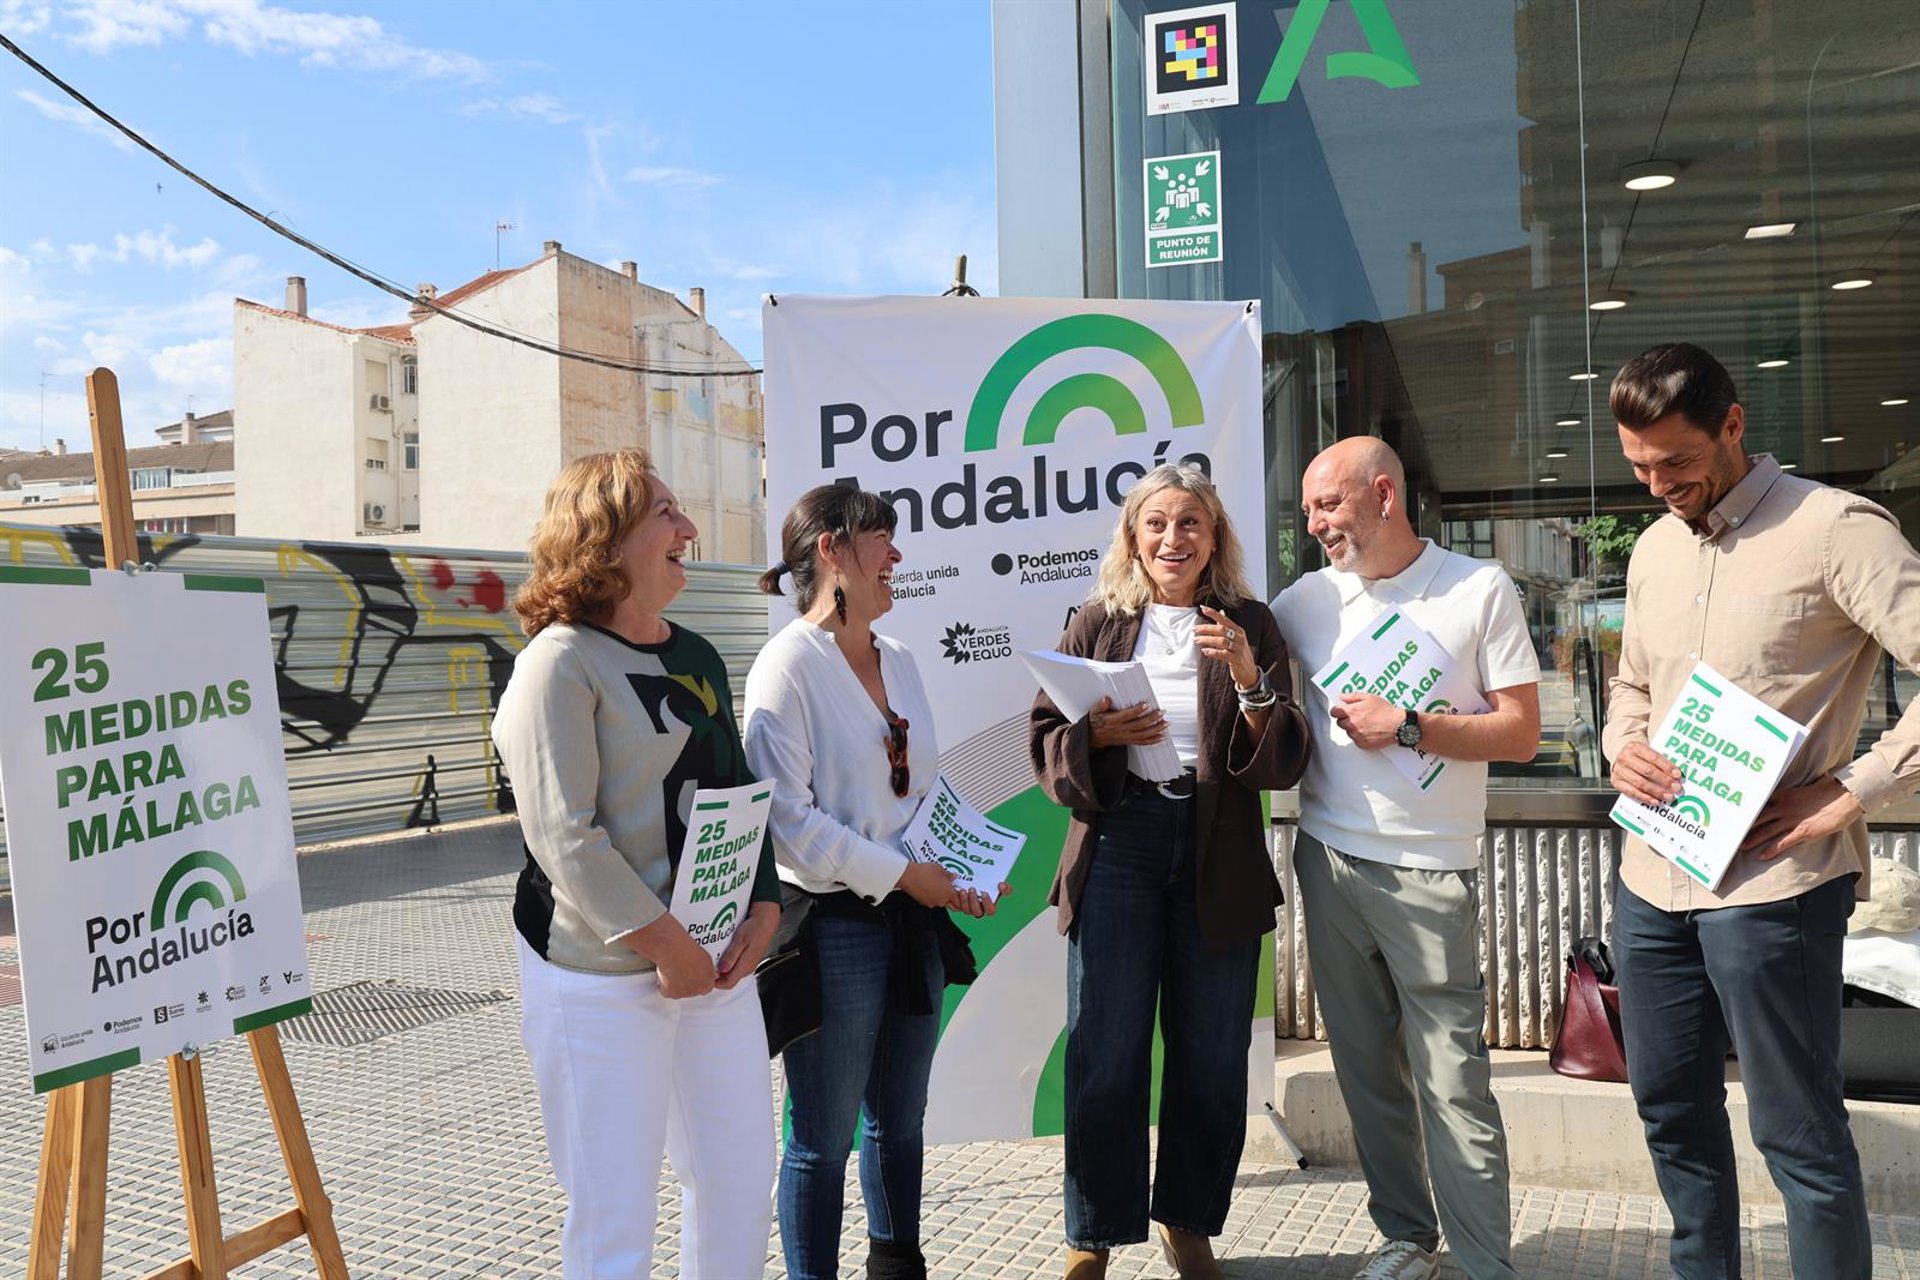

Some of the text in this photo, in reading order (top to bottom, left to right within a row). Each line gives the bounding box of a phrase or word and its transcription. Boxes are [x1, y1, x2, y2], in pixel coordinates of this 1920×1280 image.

[1157, 235, 1211, 249] PUNTO DE
[1160, 246, 1208, 260] REUNIÓN
[820, 402, 952, 469] Por
[834, 439, 1217, 534] ndaluc
[889, 564, 960, 585] uierda unida
[1018, 548, 1099, 570] Podemos
[1020, 563, 1092, 585] Andalucía
[892, 582, 937, 600] dalucía
[959, 632, 1010, 649] VERDES
[973, 646, 1012, 661] EQUO
[31, 641, 110, 703] 25
[1367, 640, 1418, 696] EDIDAS
[1385, 680, 1409, 705] RA
[1401, 666, 1442, 711] LAGA
[45, 679, 252, 756] MEDIDAS
[1680, 697, 1715, 724] 25
[1665, 735, 1719, 772] PARA
[1673, 717, 1766, 773] MEDIDAS
[56, 743, 186, 809] PARA
[67, 774, 261, 862] MÁLAGA
[938, 792, 958, 817] 25
[694, 826, 759, 865] MEDIDAS
[697, 820, 727, 845] 25
[931, 811, 967, 849] PARA
[934, 802, 1004, 852] MEDIDAS
[923, 839, 937, 858] Por
[689, 865, 750, 904] MÁLAGA
[692, 858, 738, 884] PARA
[85, 911, 146, 954] Por
[688, 923, 710, 935] Por
[91, 906, 254, 994] Andalucía
